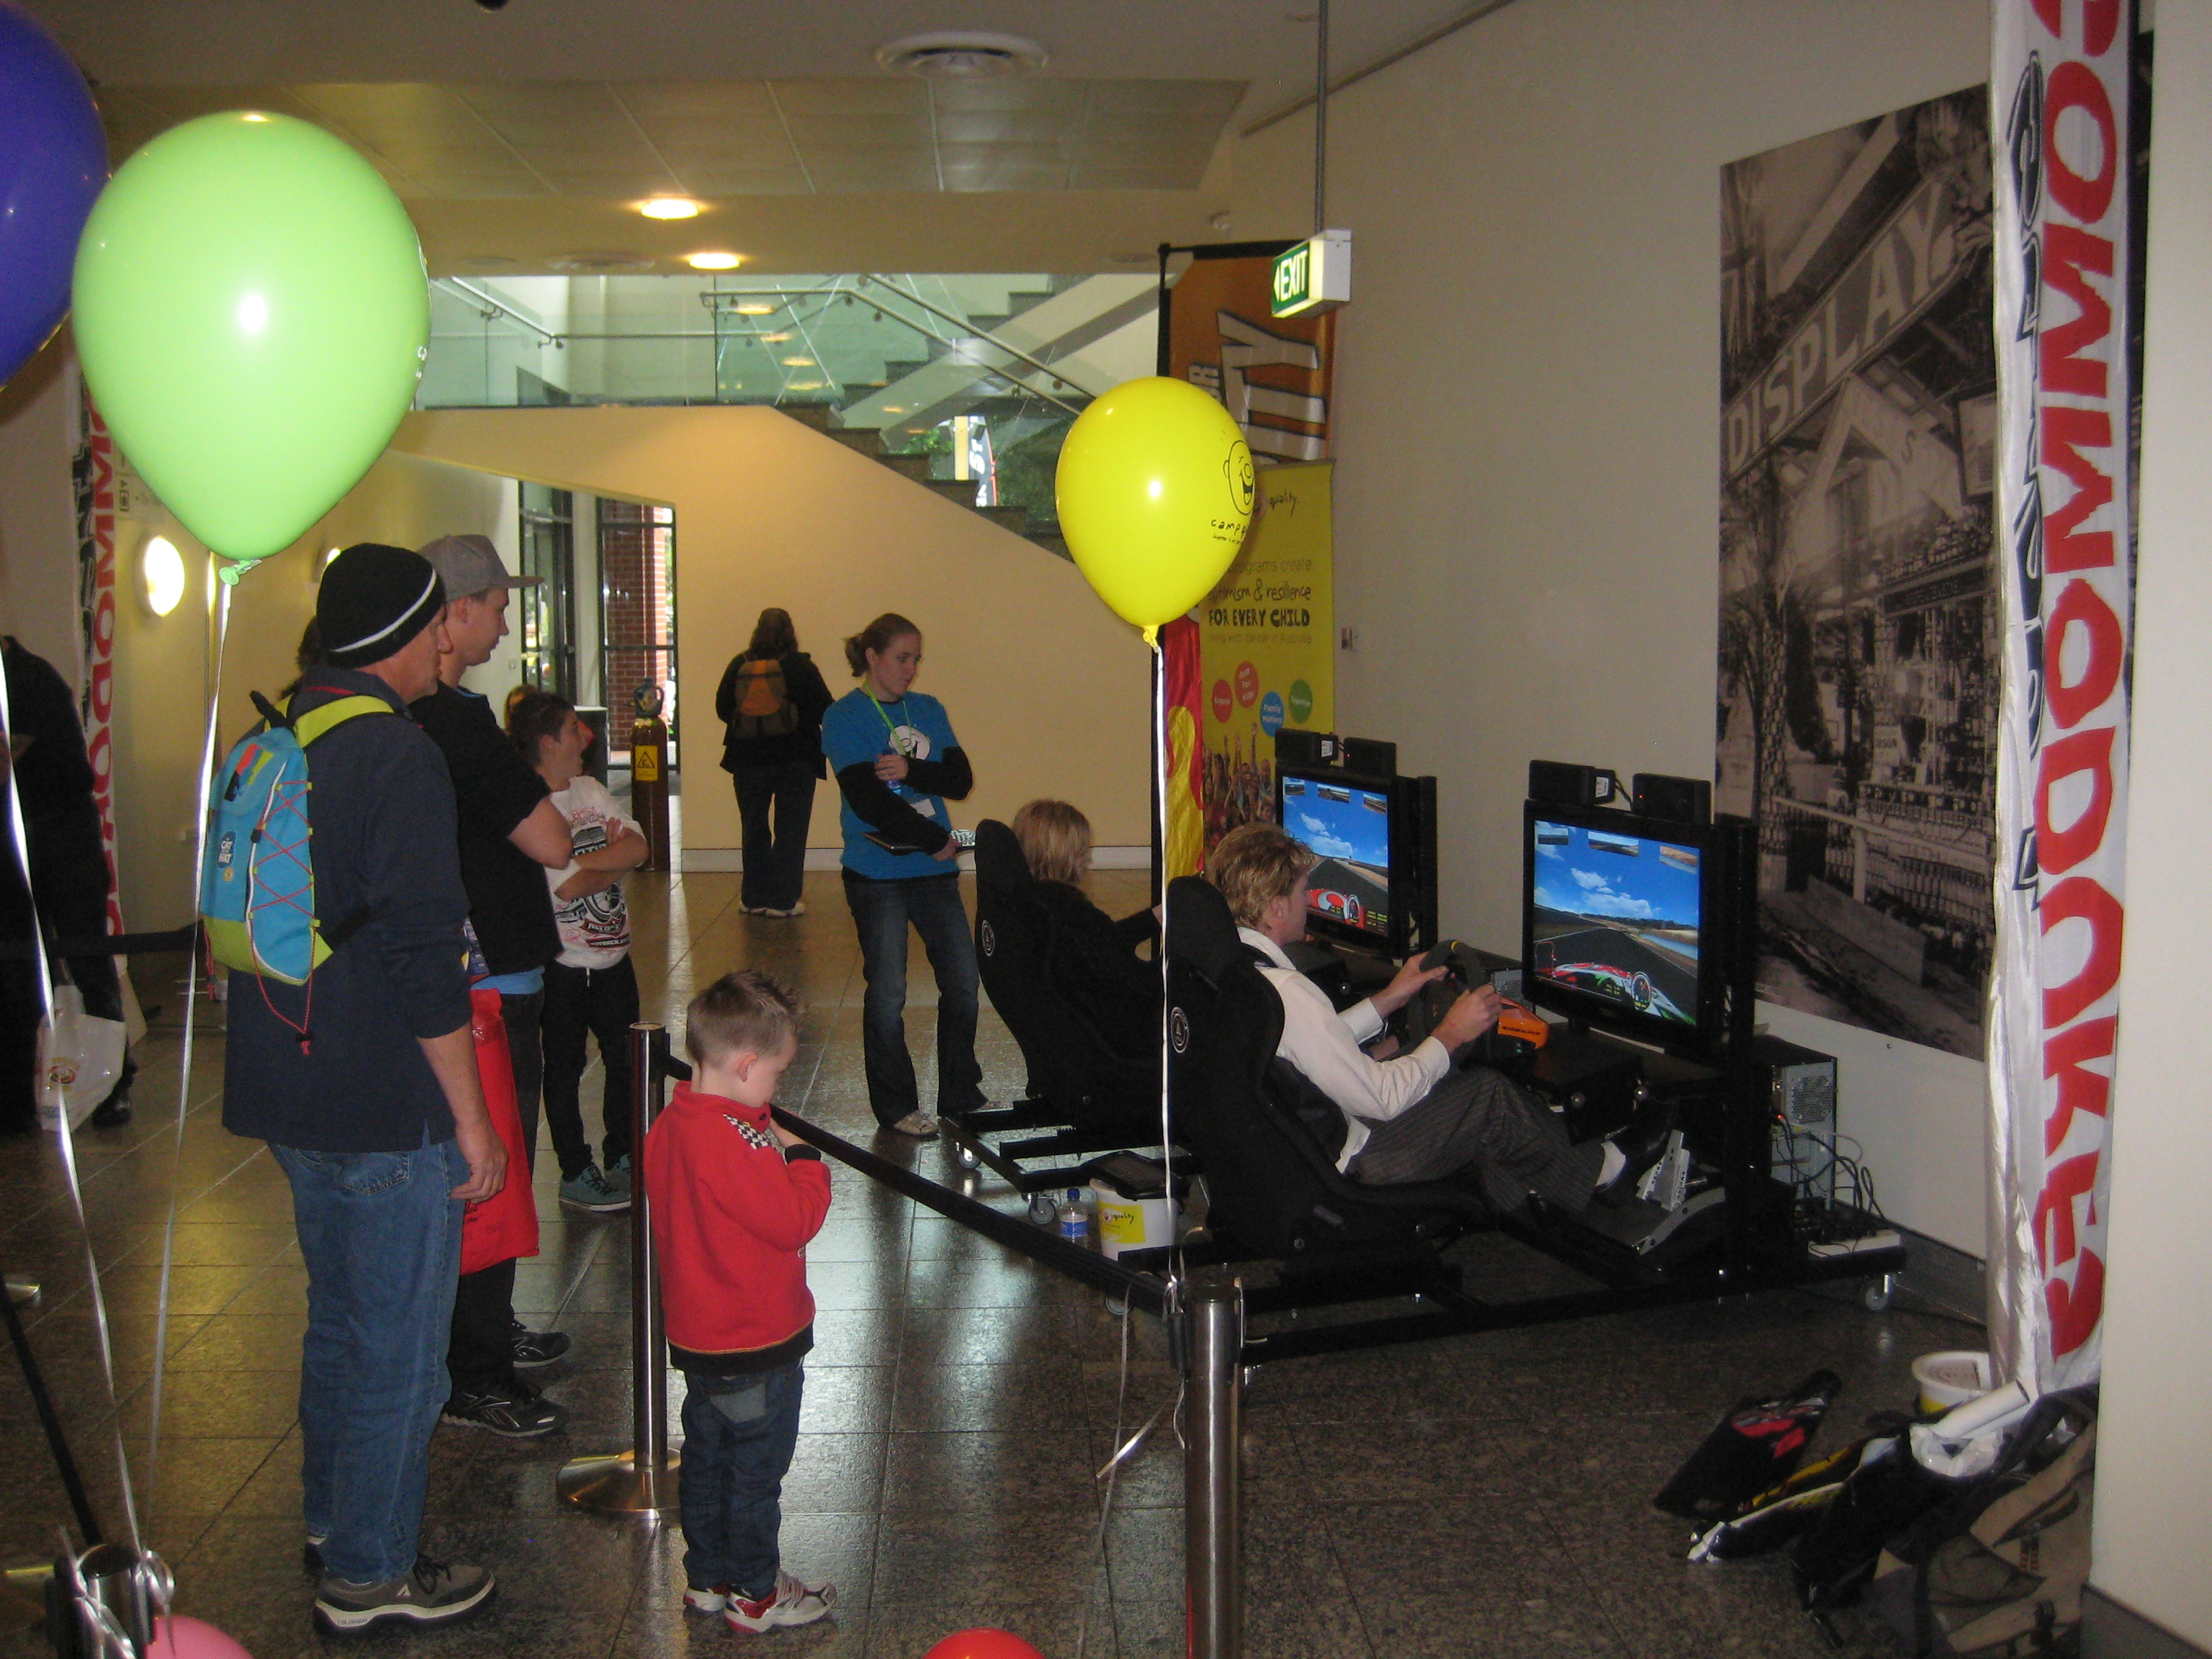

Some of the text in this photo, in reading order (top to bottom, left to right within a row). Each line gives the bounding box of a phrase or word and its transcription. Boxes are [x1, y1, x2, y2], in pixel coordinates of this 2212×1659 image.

[1280, 249, 1309, 302] EXIT
[1280, 557, 1312, 572] create
[1254, 578, 1263, 601] &
[1266, 580, 1311, 601] resilience
[1209, 608, 1310, 627] FOR EVERY CHILD
